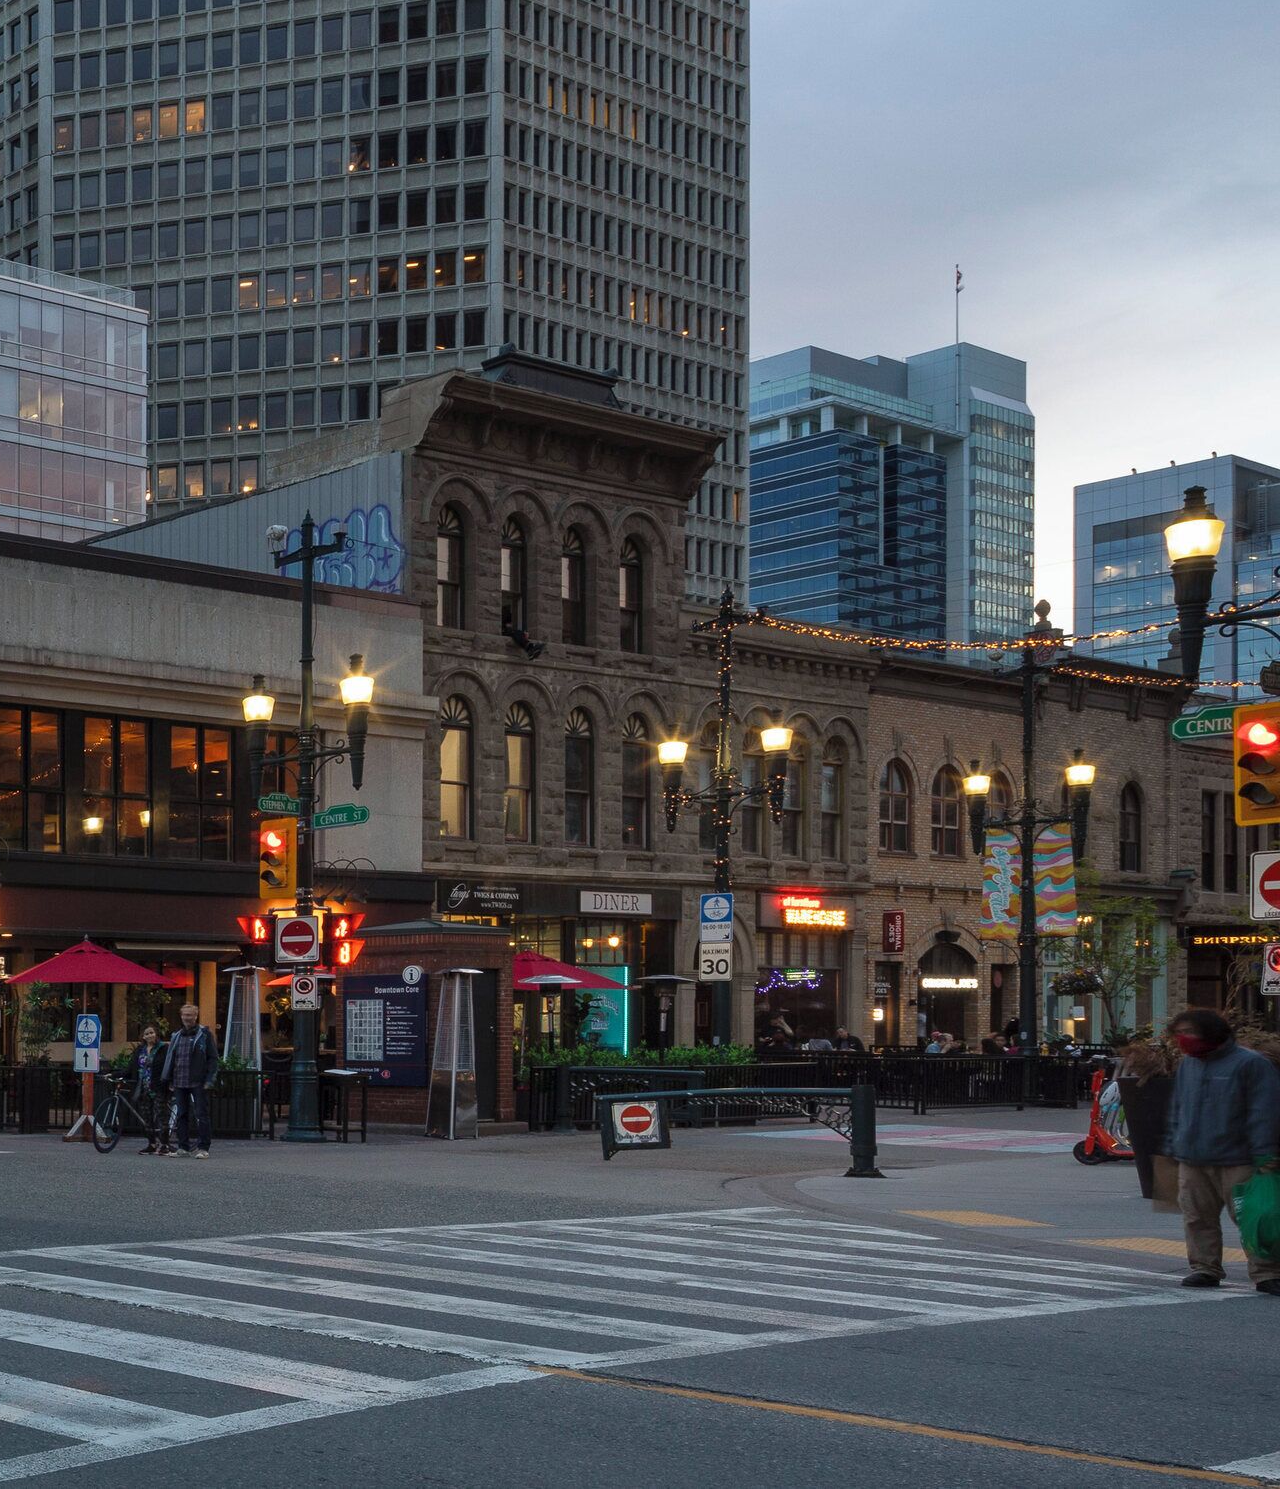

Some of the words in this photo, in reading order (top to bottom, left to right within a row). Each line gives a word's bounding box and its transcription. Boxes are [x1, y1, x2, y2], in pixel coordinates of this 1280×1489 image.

[1186, 717, 1233, 734] CENTR
[262, 800, 286, 810] STEPHEN
[287, 802, 297, 811] AVE
[320, 813, 348, 825] CENTRE
[352, 811, 362, 821] ST
[474, 891, 489, 899] TWIGS
[593, 893, 640, 911] DINER
[702, 958, 729, 975] 30
[374, 986, 405, 994] Downtown
